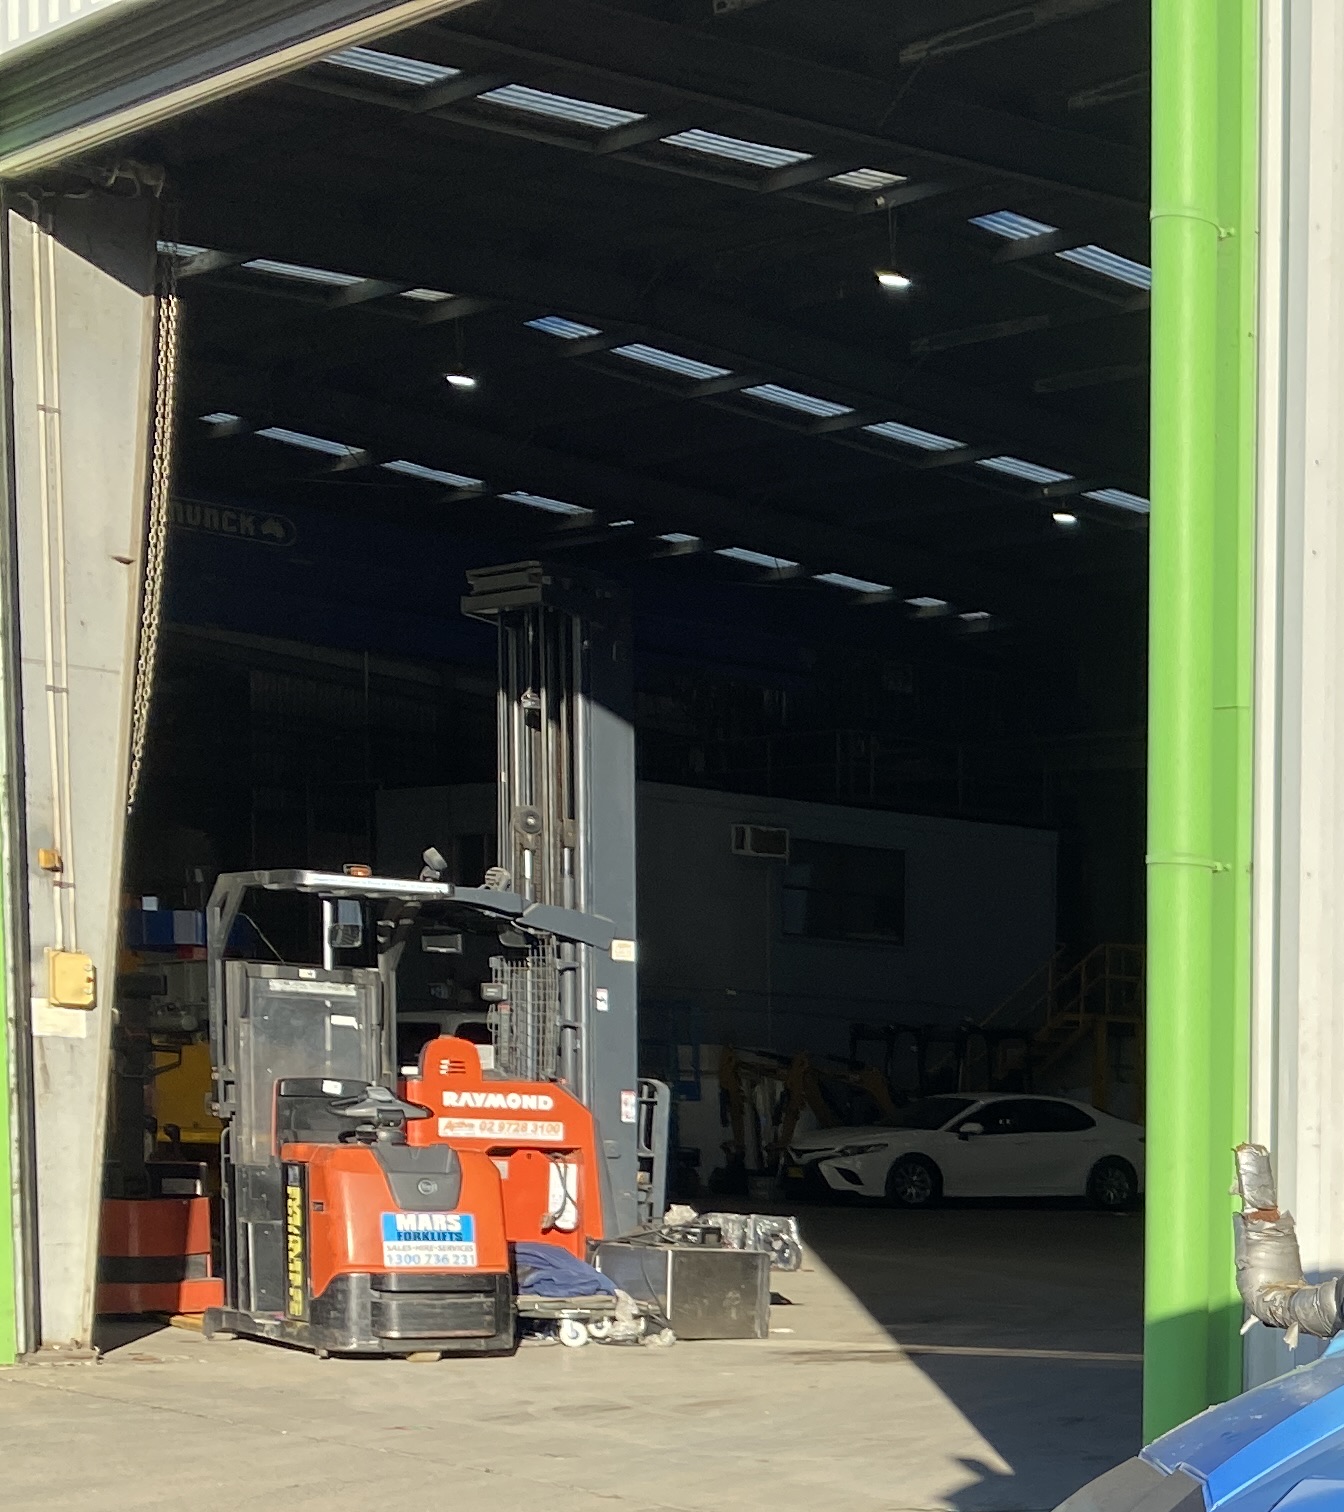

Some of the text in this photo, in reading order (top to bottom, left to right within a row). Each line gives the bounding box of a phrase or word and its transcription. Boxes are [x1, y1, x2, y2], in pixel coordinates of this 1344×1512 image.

[442, 1091, 554, 1111] RAYMOND
[396, 1213, 462, 1231] MARS
[396, 1231, 463, 1242] FORKLIFTS
[387, 1254, 475, 1265] 1300 736 231
